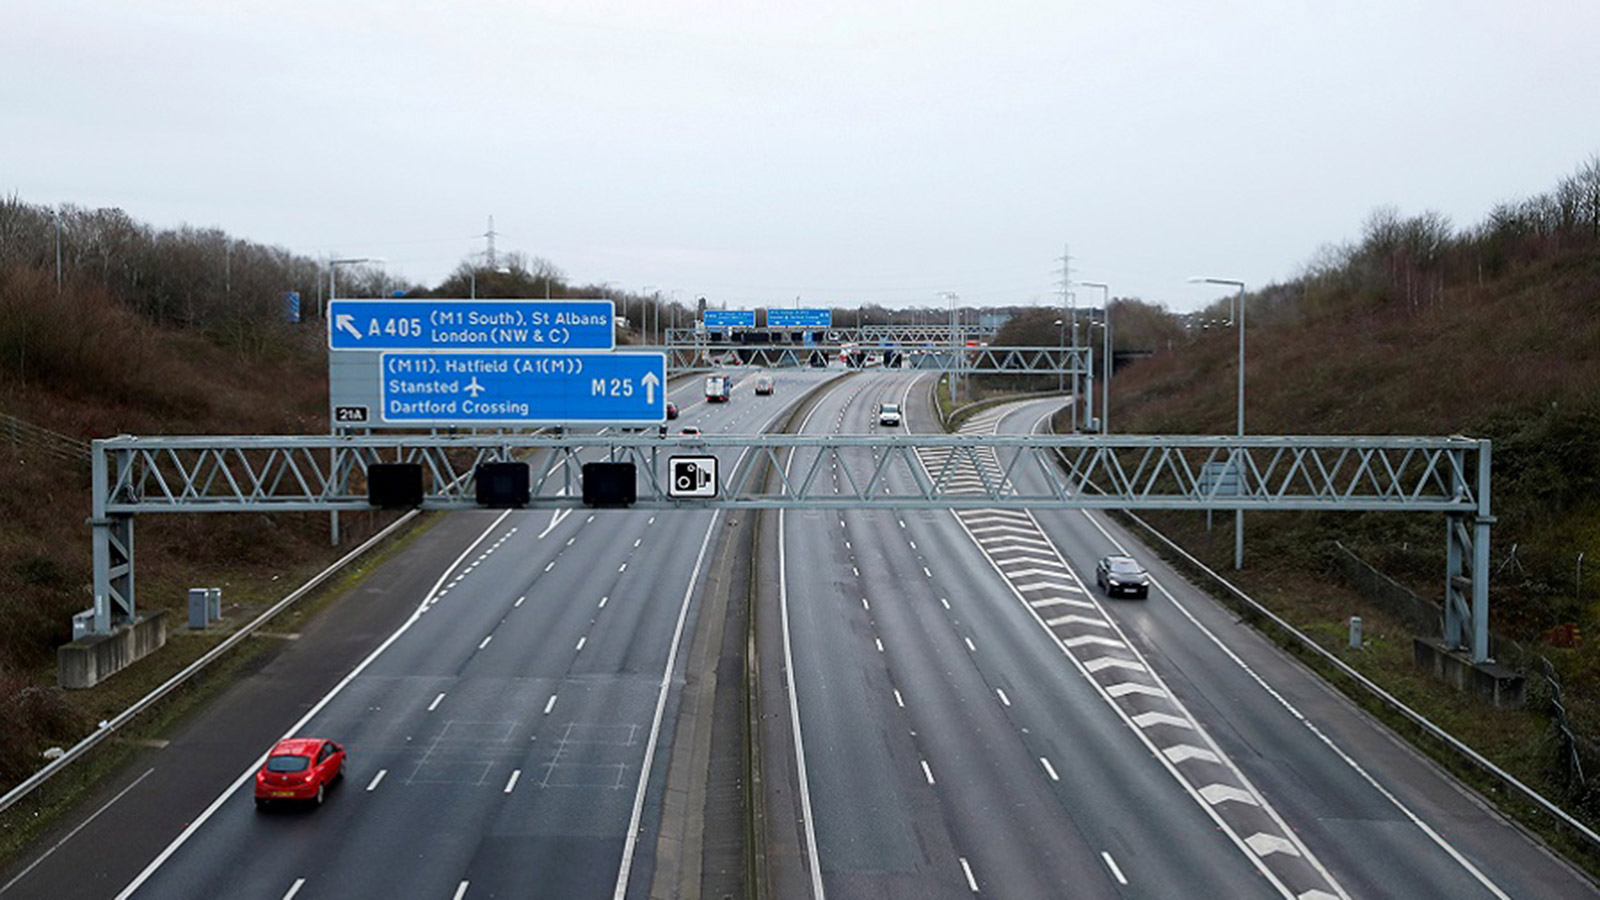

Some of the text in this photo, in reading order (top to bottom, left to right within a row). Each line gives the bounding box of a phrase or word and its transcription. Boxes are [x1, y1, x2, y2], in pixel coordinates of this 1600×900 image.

[532, 311, 550, 325] St
[555, 312, 607, 325] Albans
[431, 329, 488, 342] London
[533, 329, 544, 342] &
[548, 328, 570, 344] C)
[445, 359, 508, 373] Hatfield
[389, 380, 459, 393] Stansted
[339, 408, 363, 420] 21A
[390, 400, 529, 416] Dartford Crossing
